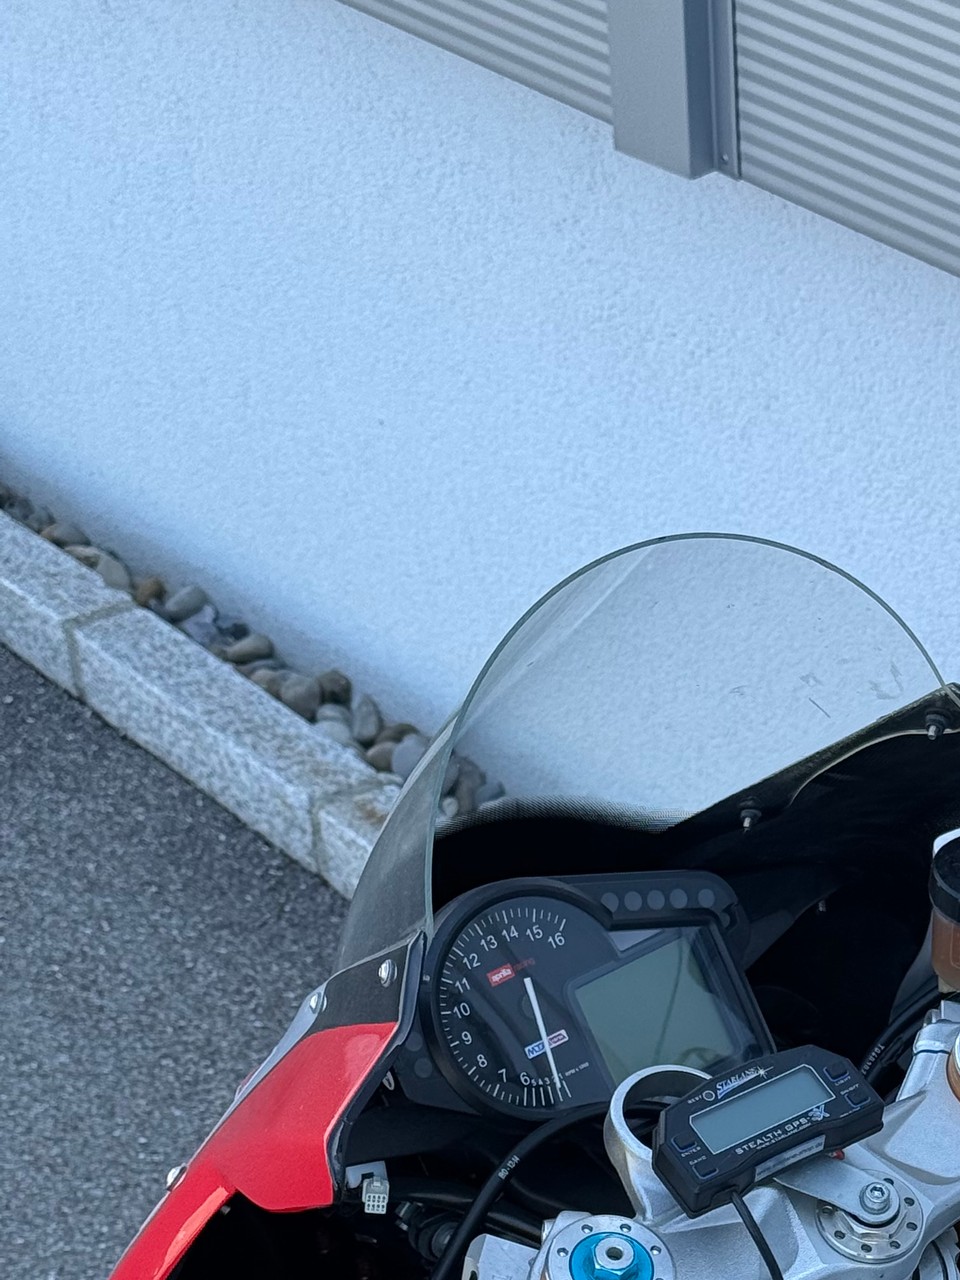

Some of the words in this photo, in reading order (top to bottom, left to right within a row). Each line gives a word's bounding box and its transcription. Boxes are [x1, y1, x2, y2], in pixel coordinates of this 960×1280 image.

[501, 925, 519, 942] 14
[525, 925, 543, 941] 15
[547, 932, 565, 949] 16
[480, 935, 498, 951] 13
[462, 953, 481, 970] 12
[454, 977, 471, 993] 11
[453, 1002, 471, 1019] 10
[461, 1031, 472, 1045] 9
[476, 1054, 488, 1068] 8
[498, 1068, 507, 1083] 7
[519, 1072, 531, 1086] 6
[531, 1078, 537, 1087] 5
[537, 1077, 544, 1086] 4
[544, 1077, 551, 1085] 3
[734, 1128, 782, 1155] STEALTH
